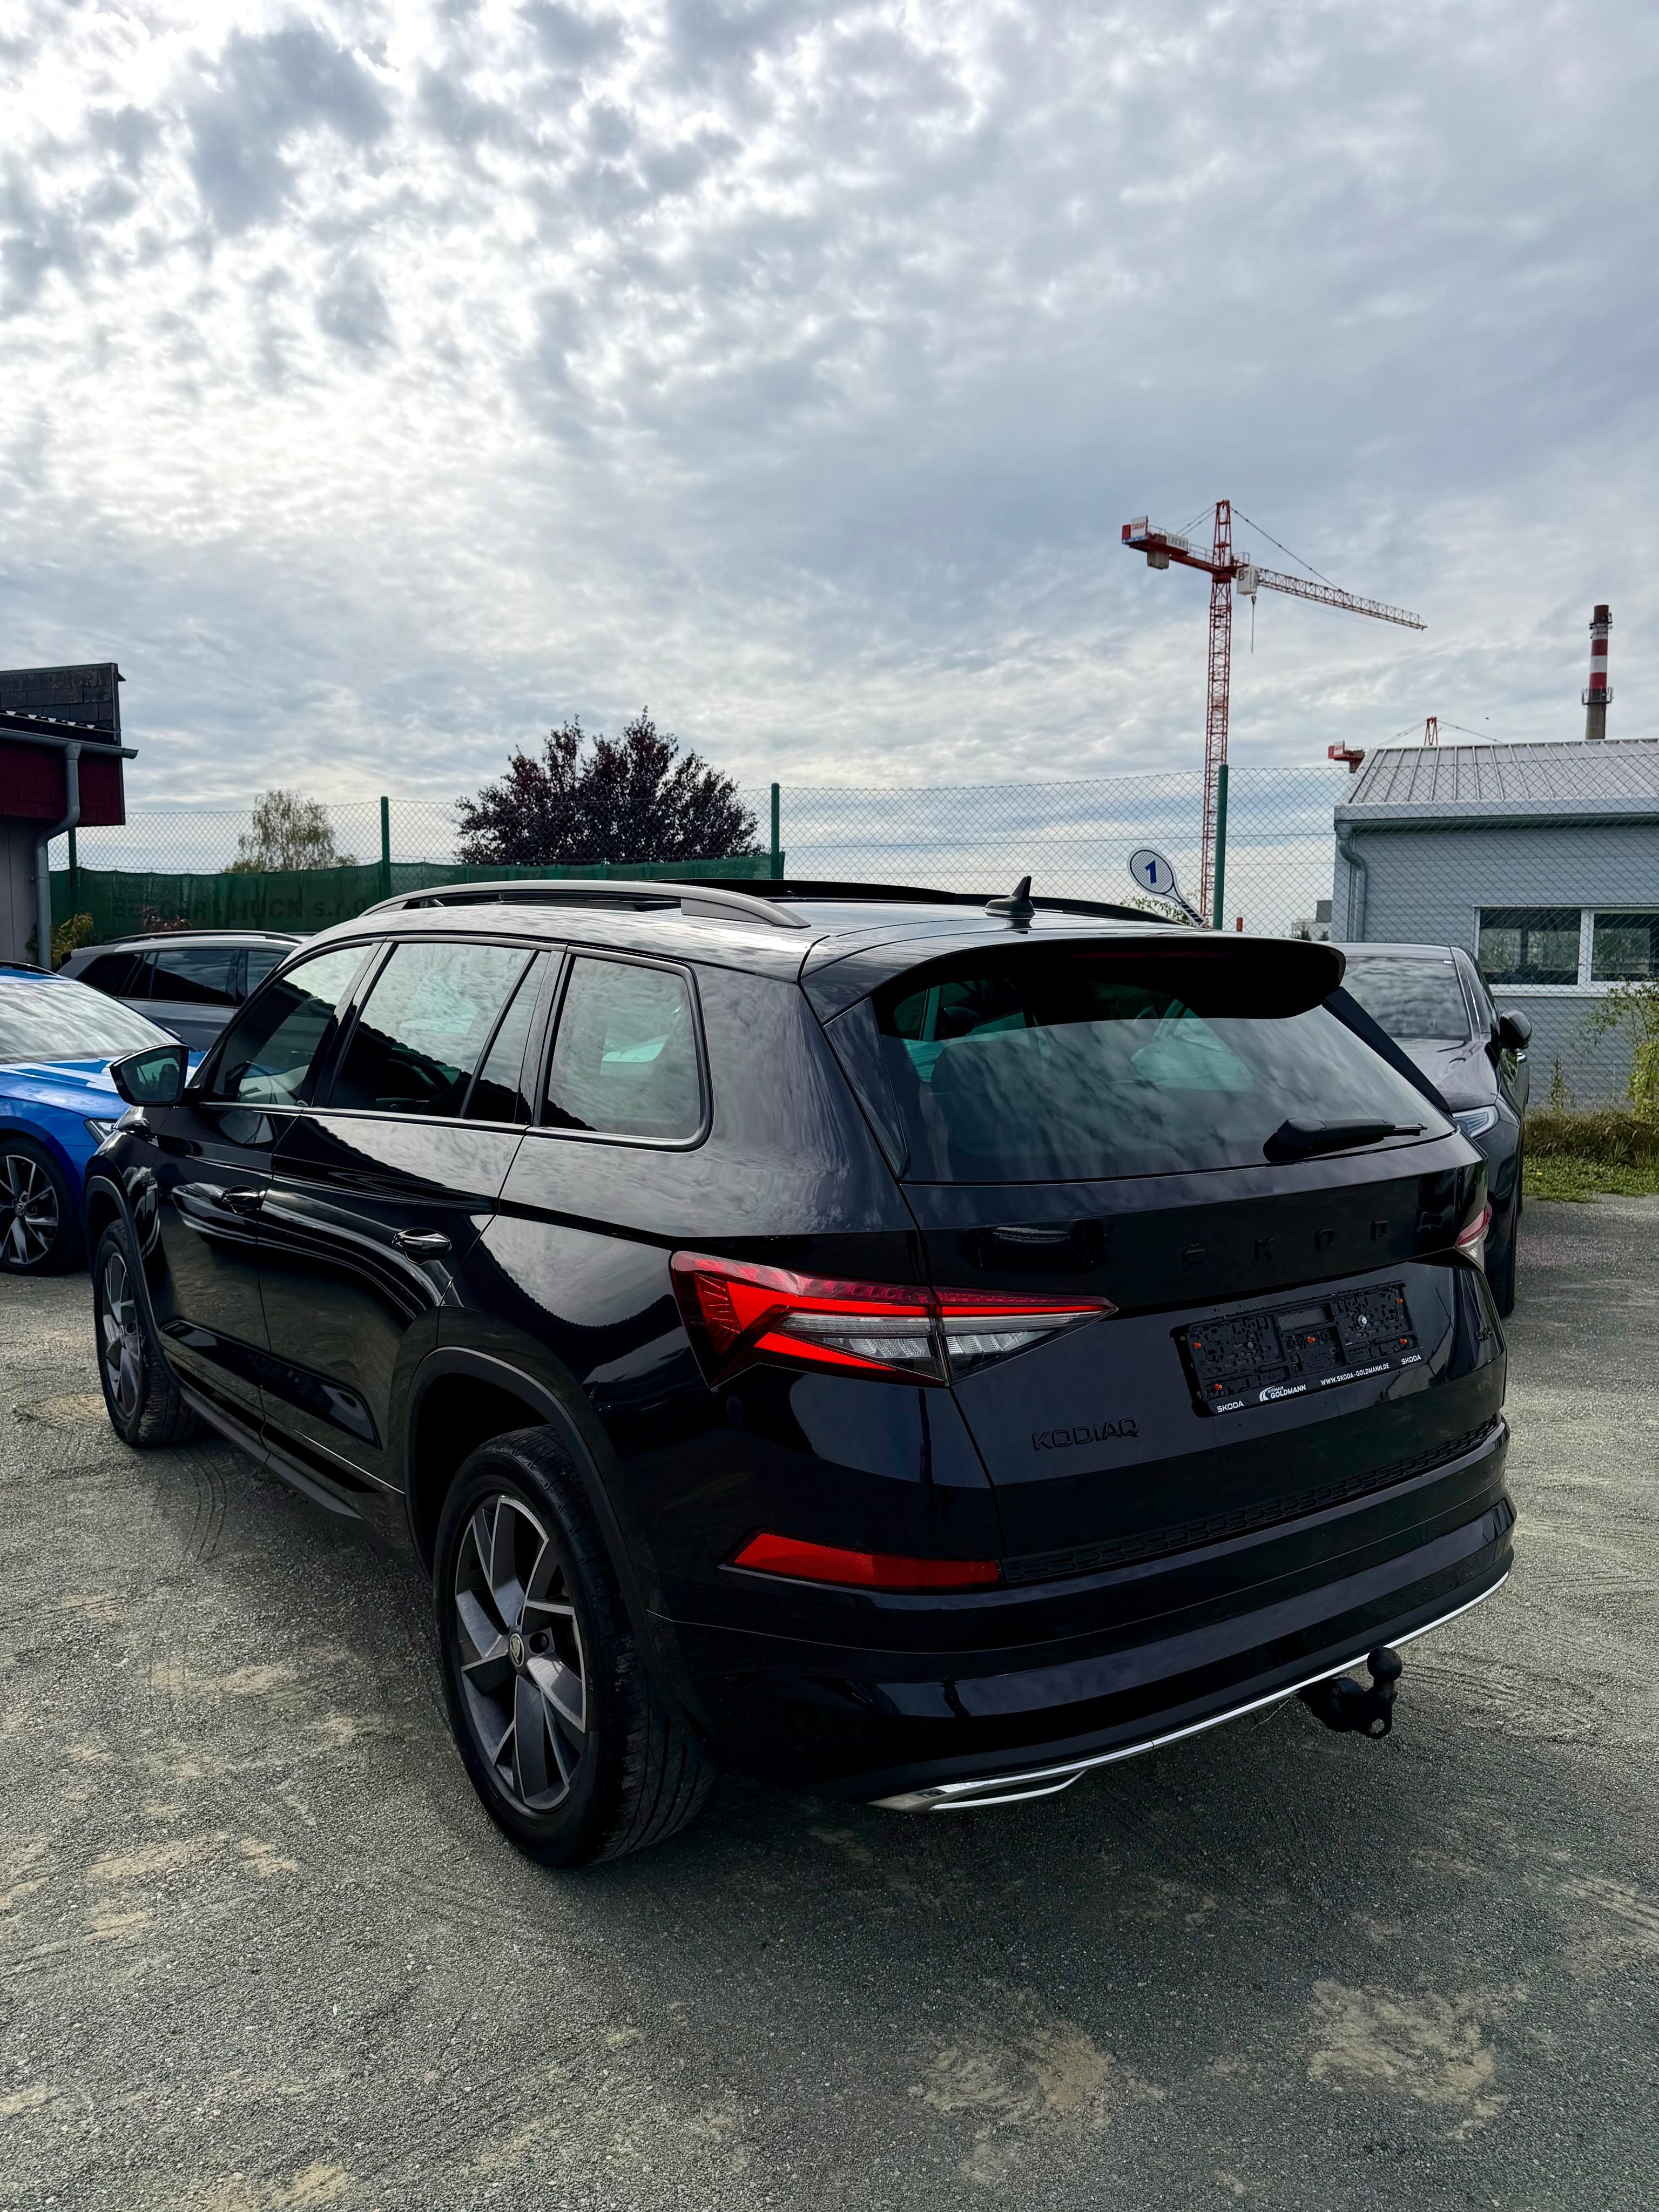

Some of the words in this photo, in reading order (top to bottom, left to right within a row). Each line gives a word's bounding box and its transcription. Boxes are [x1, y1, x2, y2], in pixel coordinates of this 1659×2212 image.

[1144, 860, 1157, 884] 1
[1320, 1363, 1390, 1386] WWW.SKODA-GOLDMANN.DE
[1270, 1384, 1306, 1399] GOLDMANN
[1031, 1417, 1139, 1451] KODIAQ
